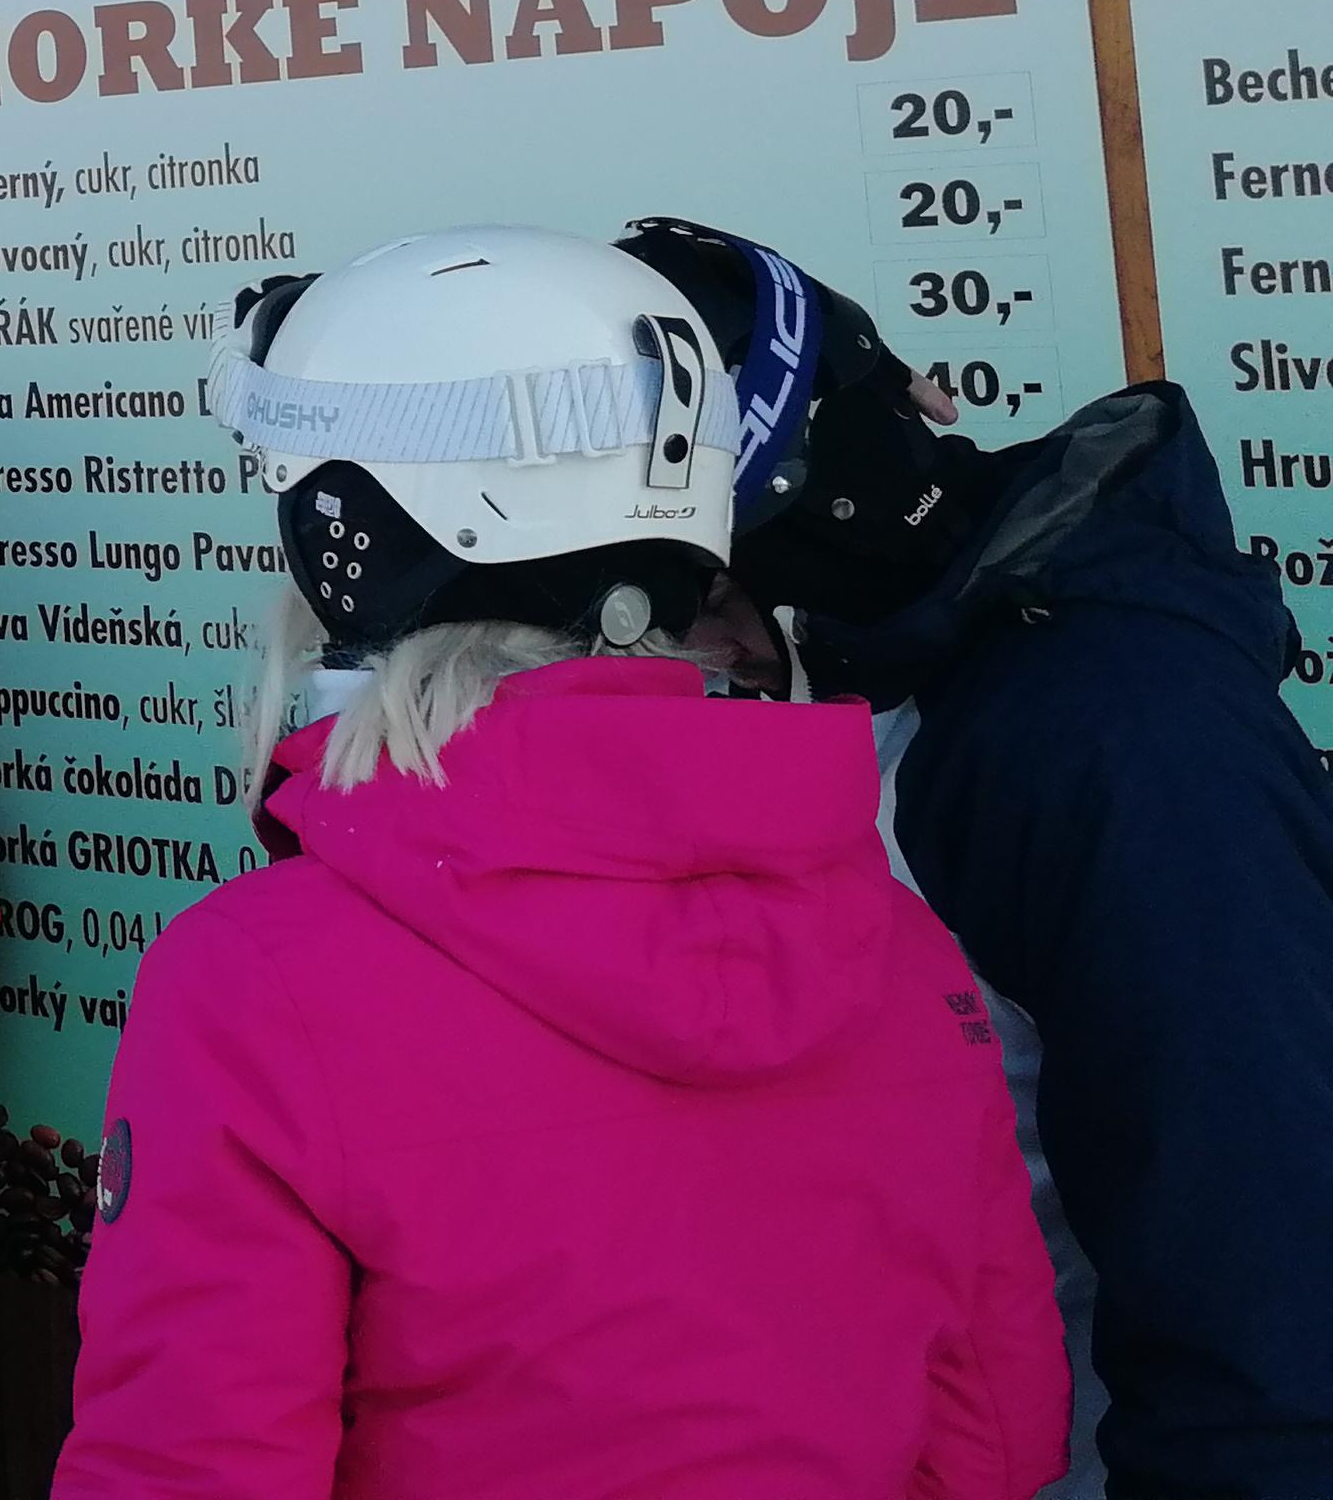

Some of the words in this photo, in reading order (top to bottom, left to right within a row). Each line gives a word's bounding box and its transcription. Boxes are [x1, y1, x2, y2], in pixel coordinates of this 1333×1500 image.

[890, 90, 1014, 144] 20,-
[76, 150, 137, 201] cukr,
[148, 142, 260, 190] citronka
[899, 179, 1024, 235] 20,-
[108, 224, 171, 275] cukr,
[181, 217, 296, 265] citronka
[68, 302, 174, 344] svařené
[908, 269, 1034, 326] 30,-
[732, 248, 806, 490] ALICE
[1230, 339, 1333, 392] Sliv
[25, 380, 184, 419] Americano
[84, 455, 227, 495] Ristretto
[624, 504, 679, 519] Julbo
[903, 483, 943, 526] bollé
[89, 530, 181, 582] Lungo
[38, 602, 191, 657] Vídeňská,
[140, 680, 203, 736] cukr,
[63, 755, 203, 804] čokoláda
[83, 907, 146, 959] 0,04
